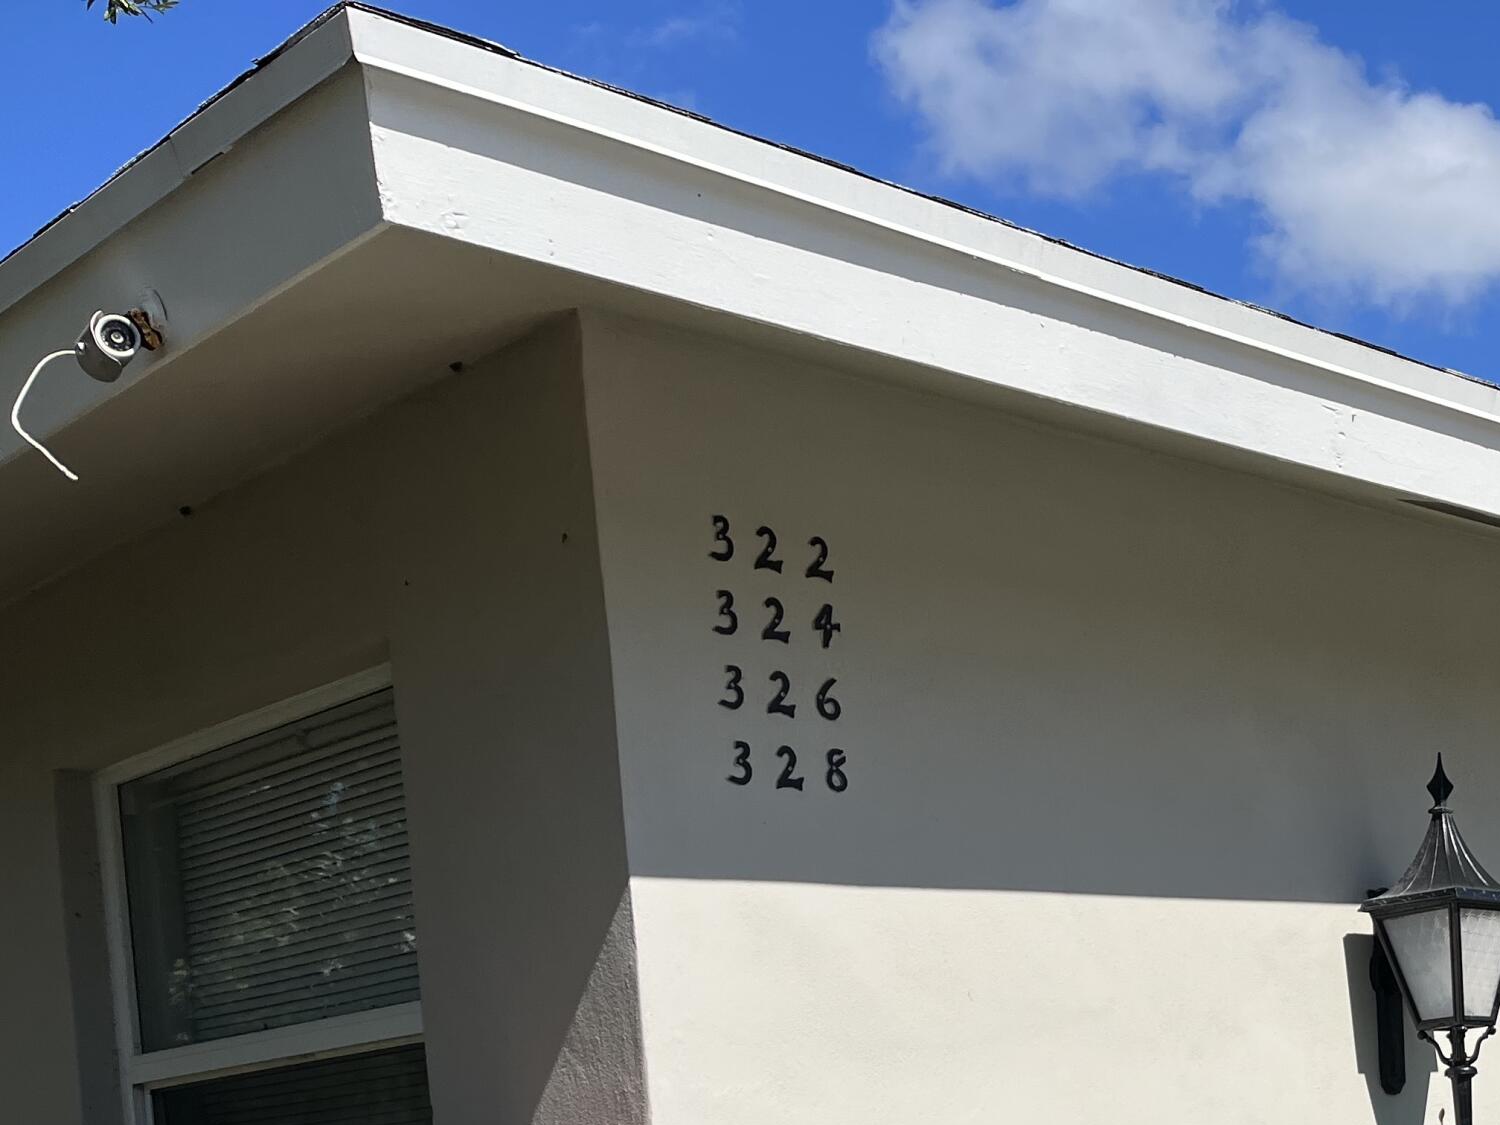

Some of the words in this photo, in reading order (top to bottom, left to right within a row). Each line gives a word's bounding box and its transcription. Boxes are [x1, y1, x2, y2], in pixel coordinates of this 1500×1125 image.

[708, 515, 836, 584] 322
[712, 590, 842, 649] 324
[718, 665, 842, 721] 326
[726, 741, 848, 792] 328
